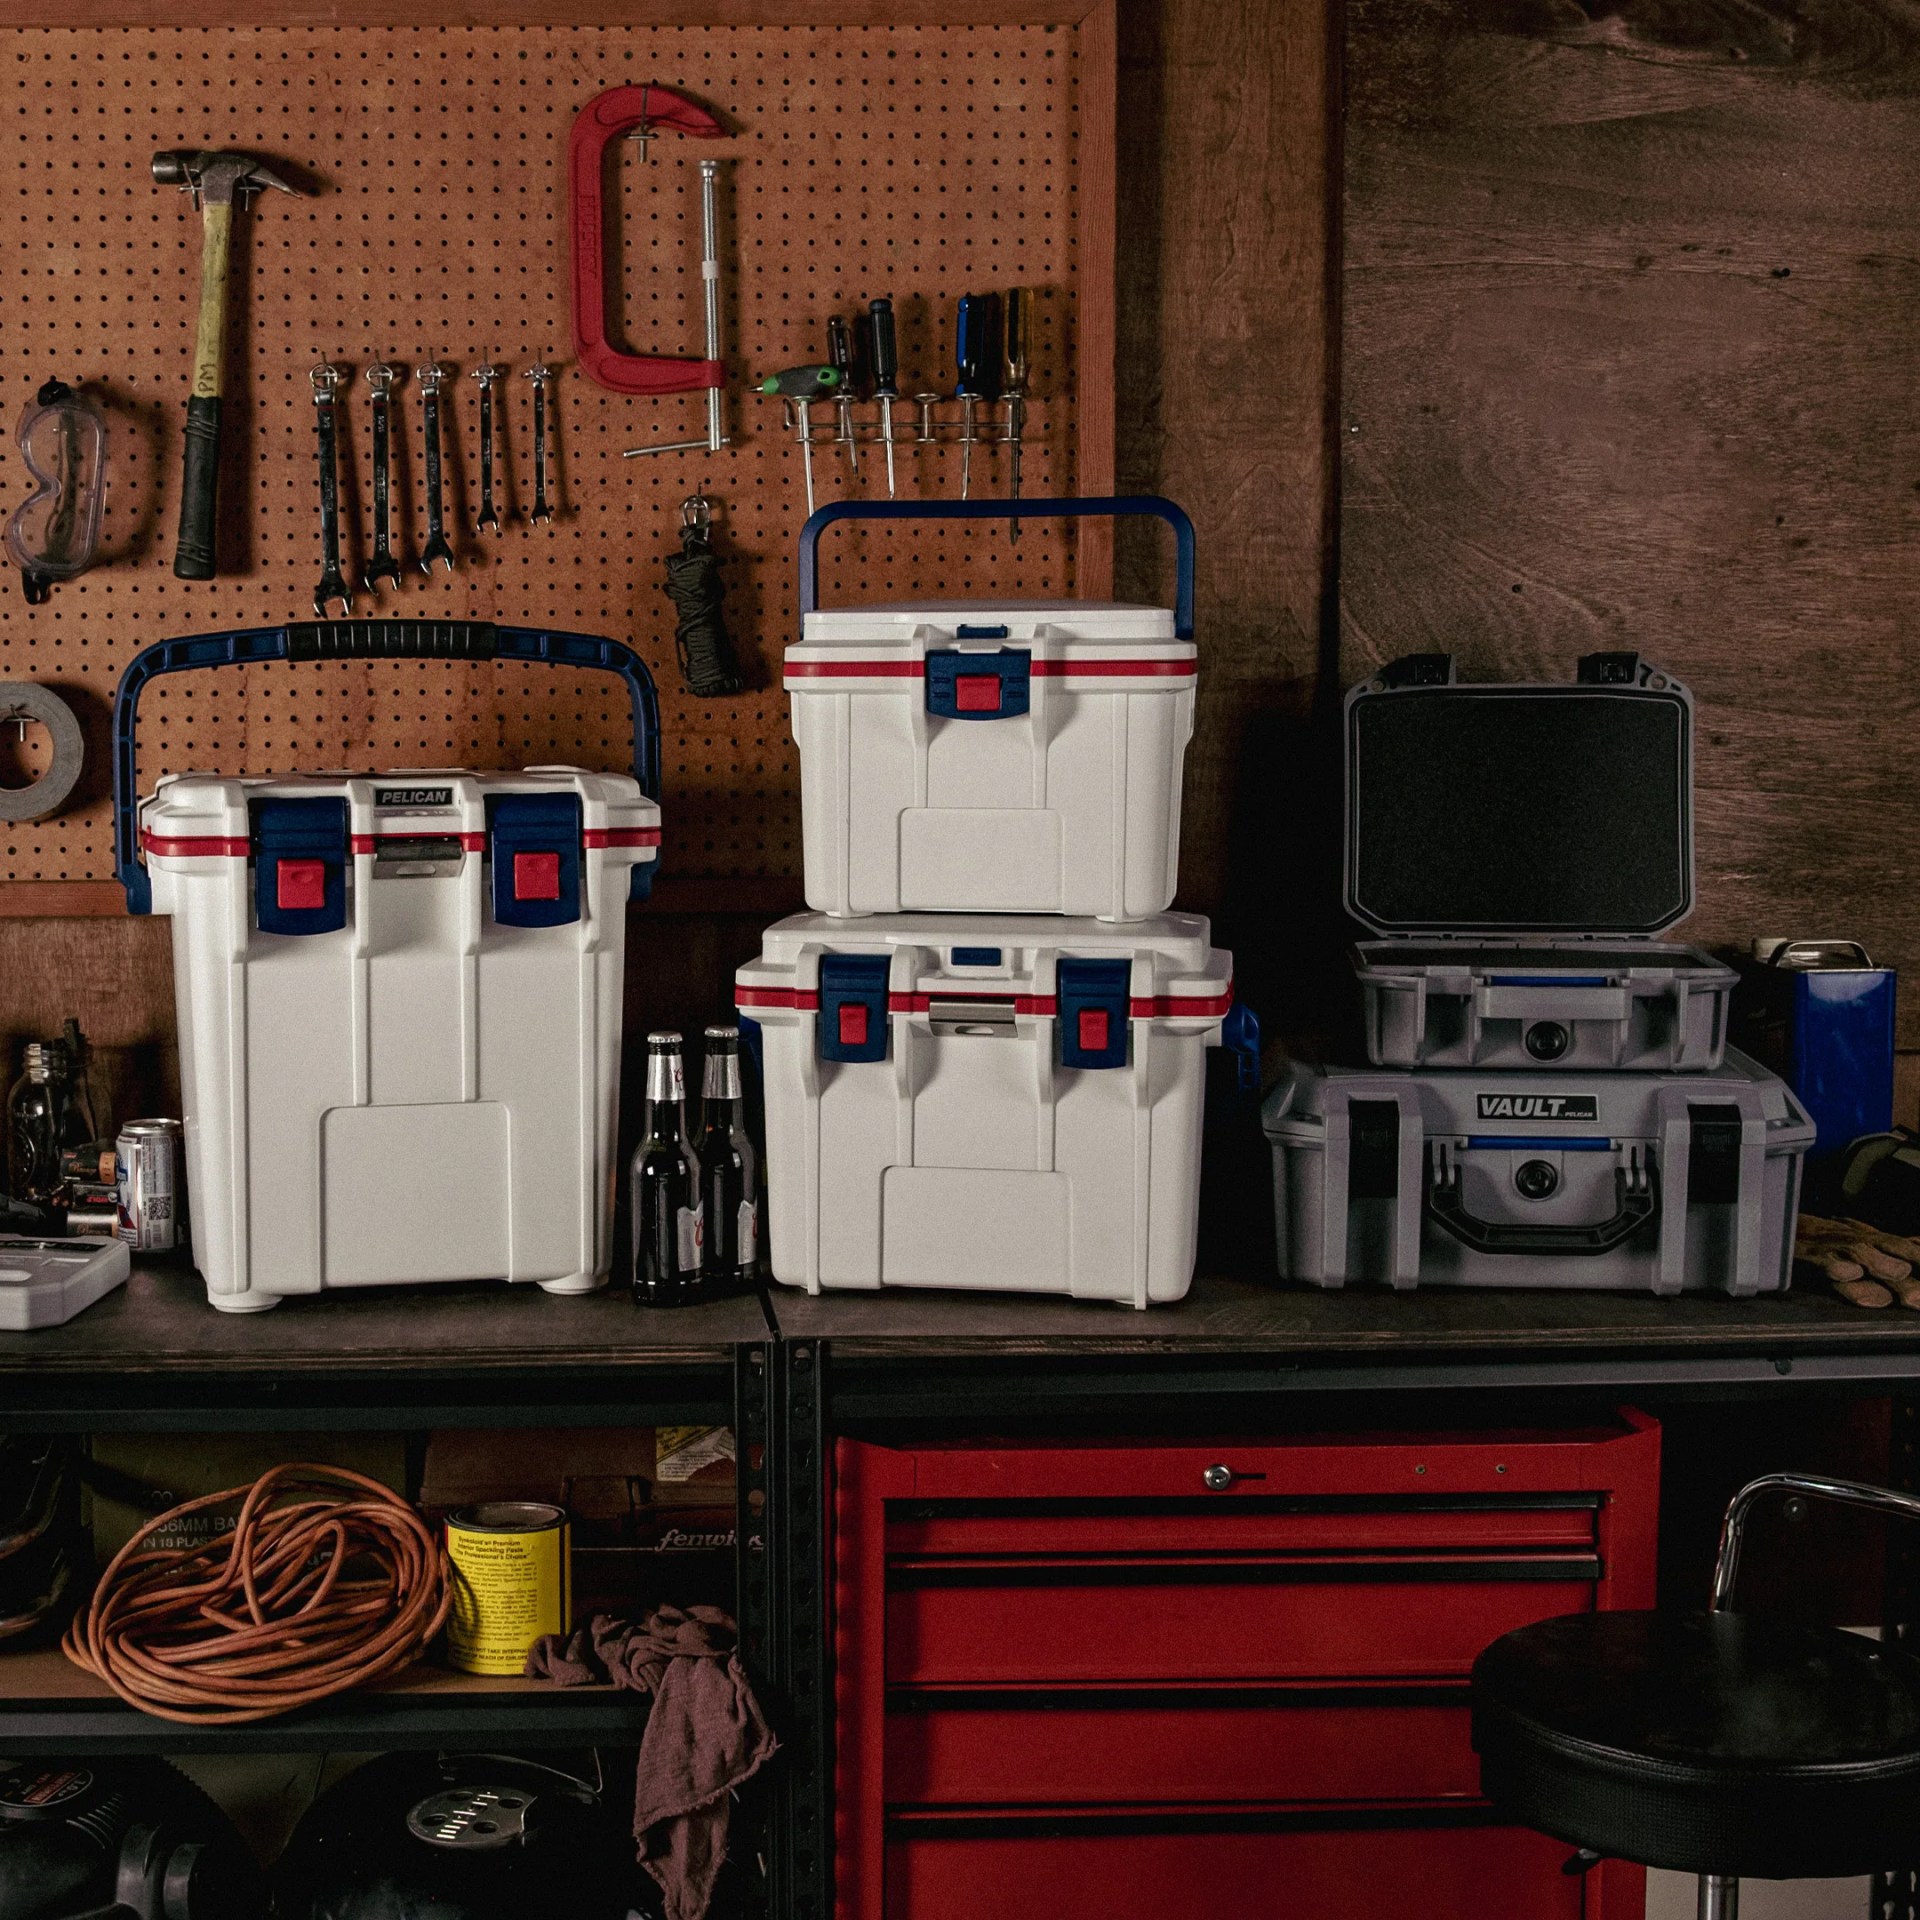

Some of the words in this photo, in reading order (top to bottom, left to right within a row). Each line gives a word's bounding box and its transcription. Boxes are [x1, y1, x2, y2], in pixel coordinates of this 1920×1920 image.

[381, 790, 447, 803] PELICAN
[1480, 1097, 1566, 1117] VAULT
[654, 1528, 764, 1552] fenwik
